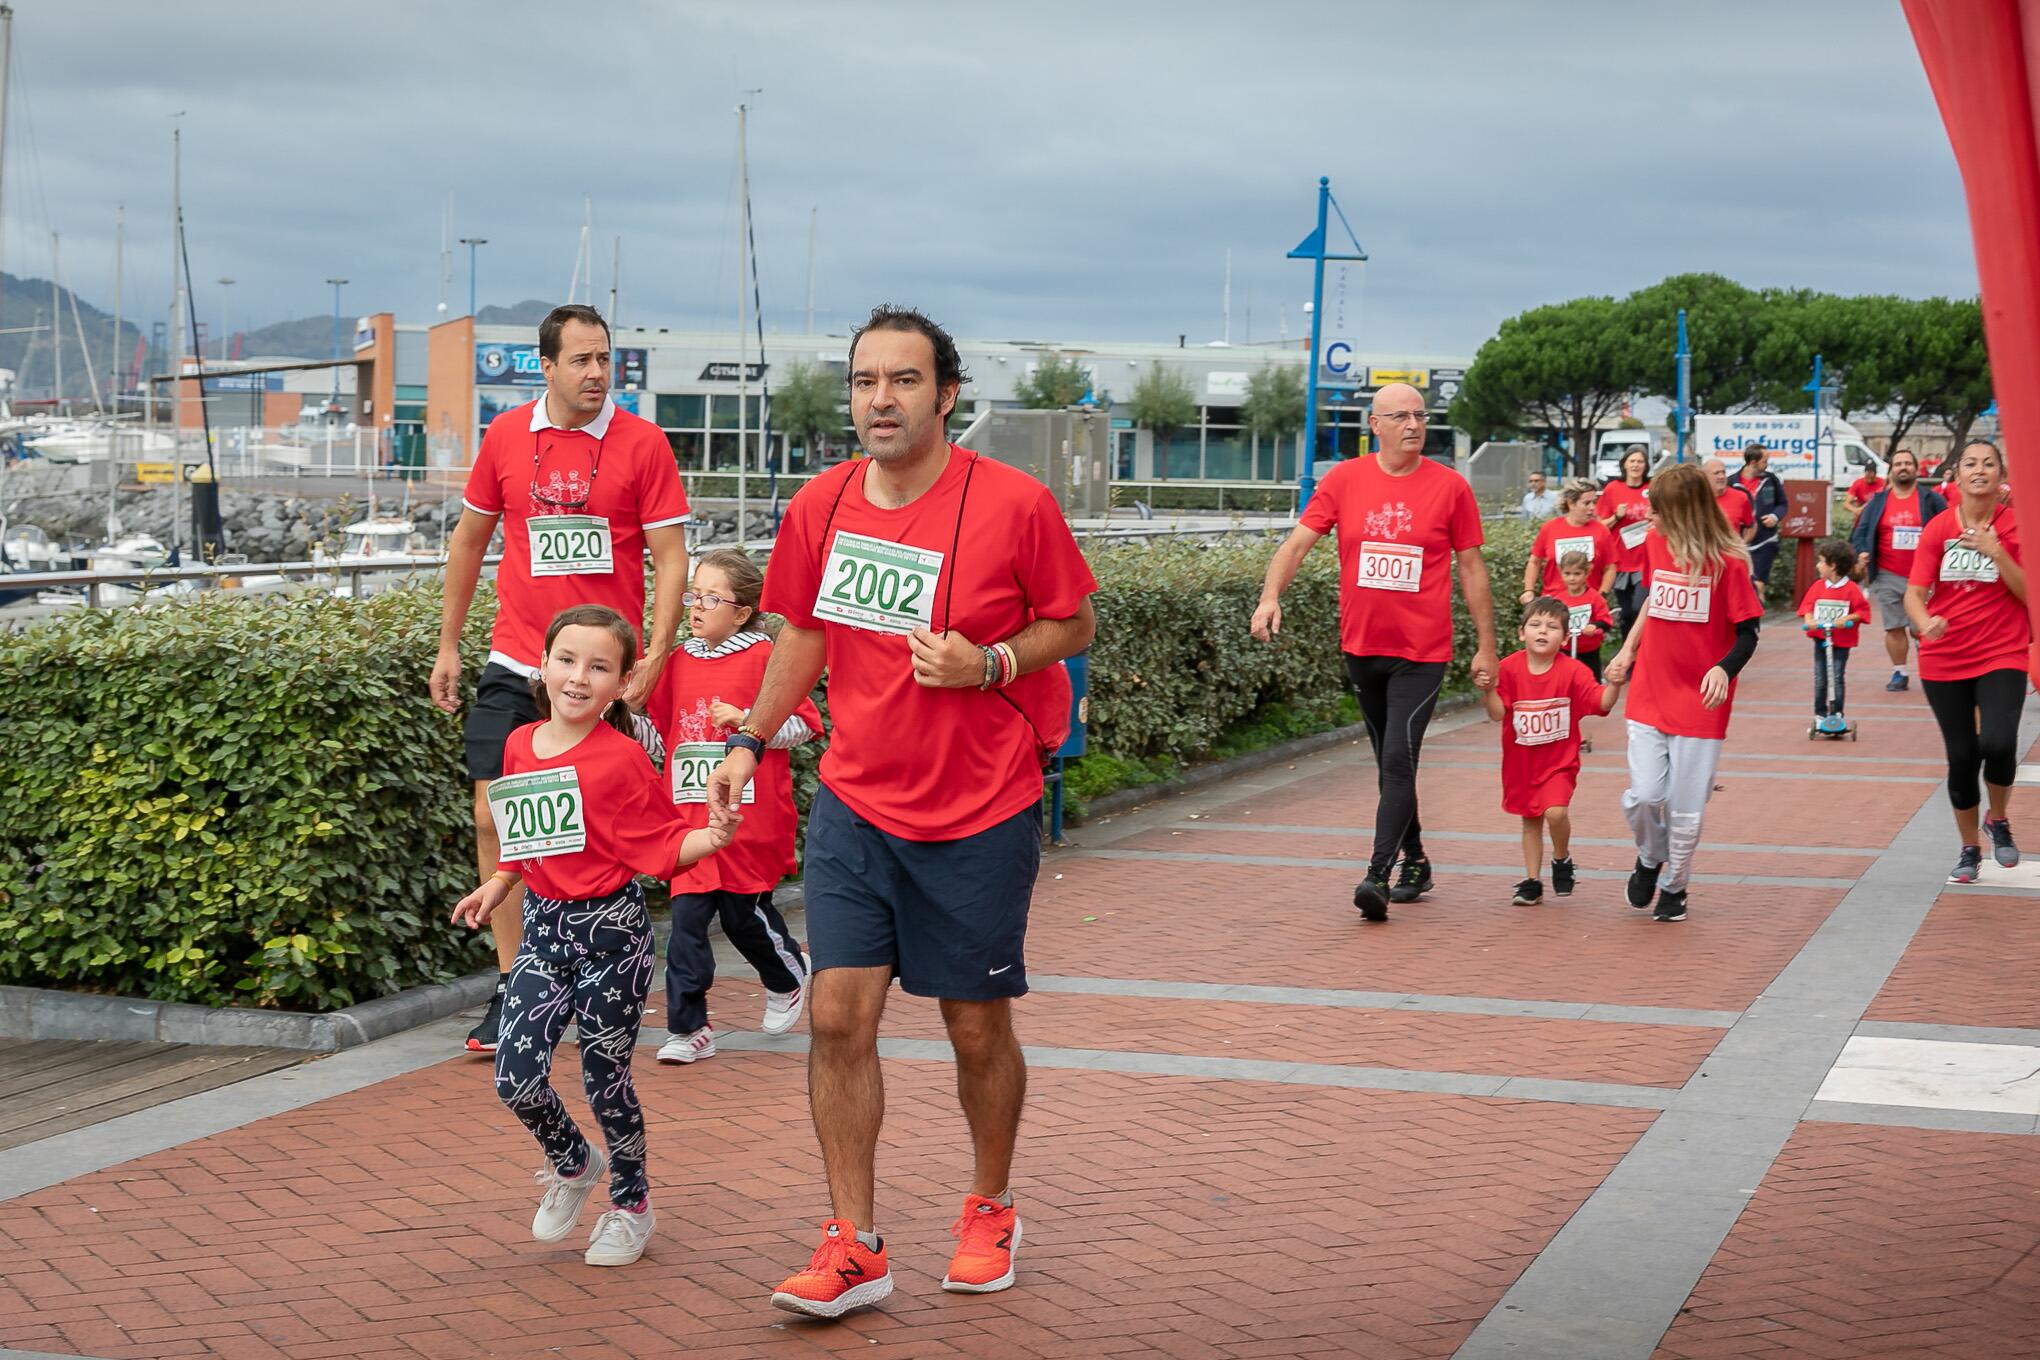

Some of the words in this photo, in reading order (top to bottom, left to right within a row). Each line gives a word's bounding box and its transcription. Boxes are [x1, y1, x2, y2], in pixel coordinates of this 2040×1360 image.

[1326, 342, 1352, 373] C
[1821, 426, 1833, 440] A
[539, 531, 602, 560] 2020
[1366, 556, 1413, 580] 3001
[832, 559, 924, 615] 2002
[1655, 585, 1700, 611] 3001
[1519, 711, 1560, 734] 3001
[681, 759, 724, 787] 20
[505, 792, 579, 839] 2002
